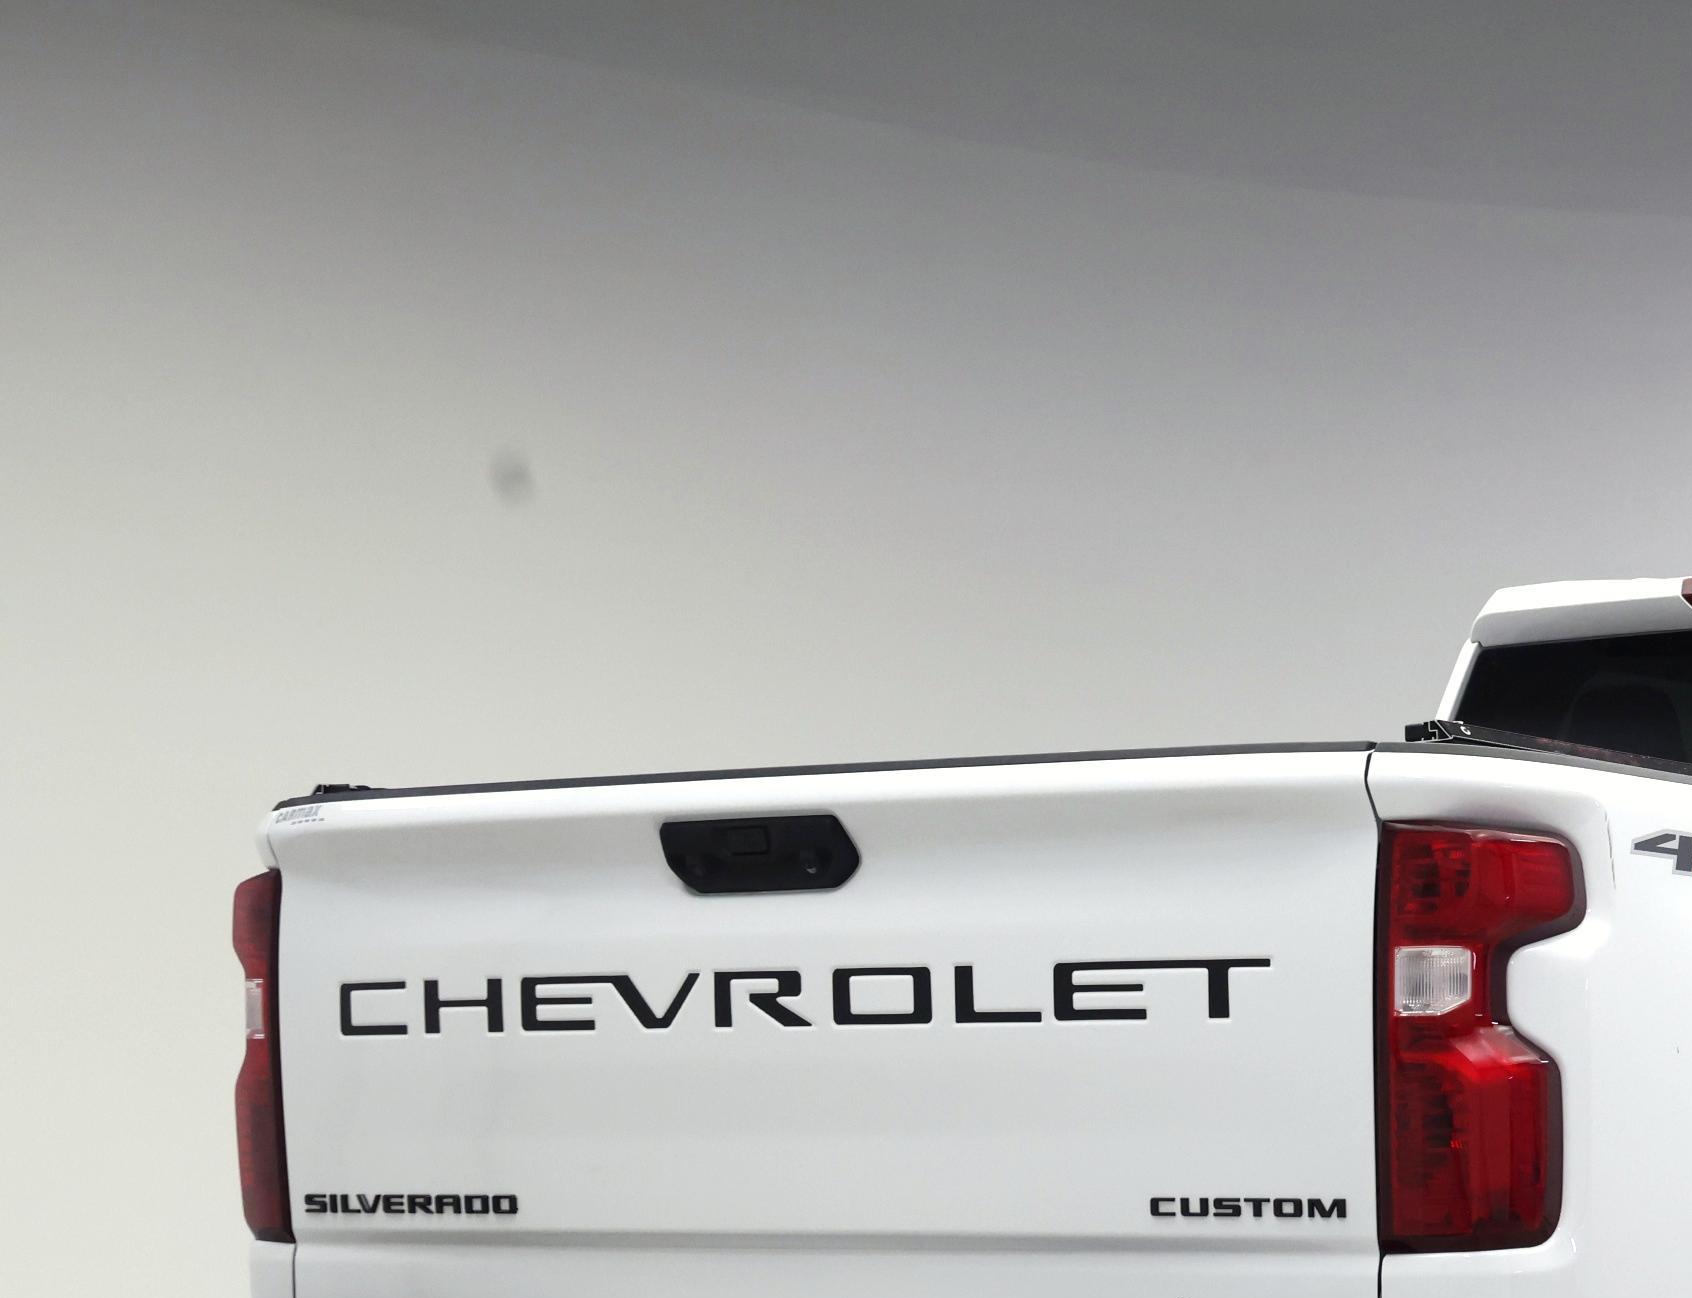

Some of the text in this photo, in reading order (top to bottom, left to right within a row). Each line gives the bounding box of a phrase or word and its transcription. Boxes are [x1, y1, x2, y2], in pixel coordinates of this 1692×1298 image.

[340, 957, 1271, 1035] CHEVROLET
[304, 1193, 519, 1215] SILVERADO
[1150, 1197, 1347, 1218] CUSTOM
